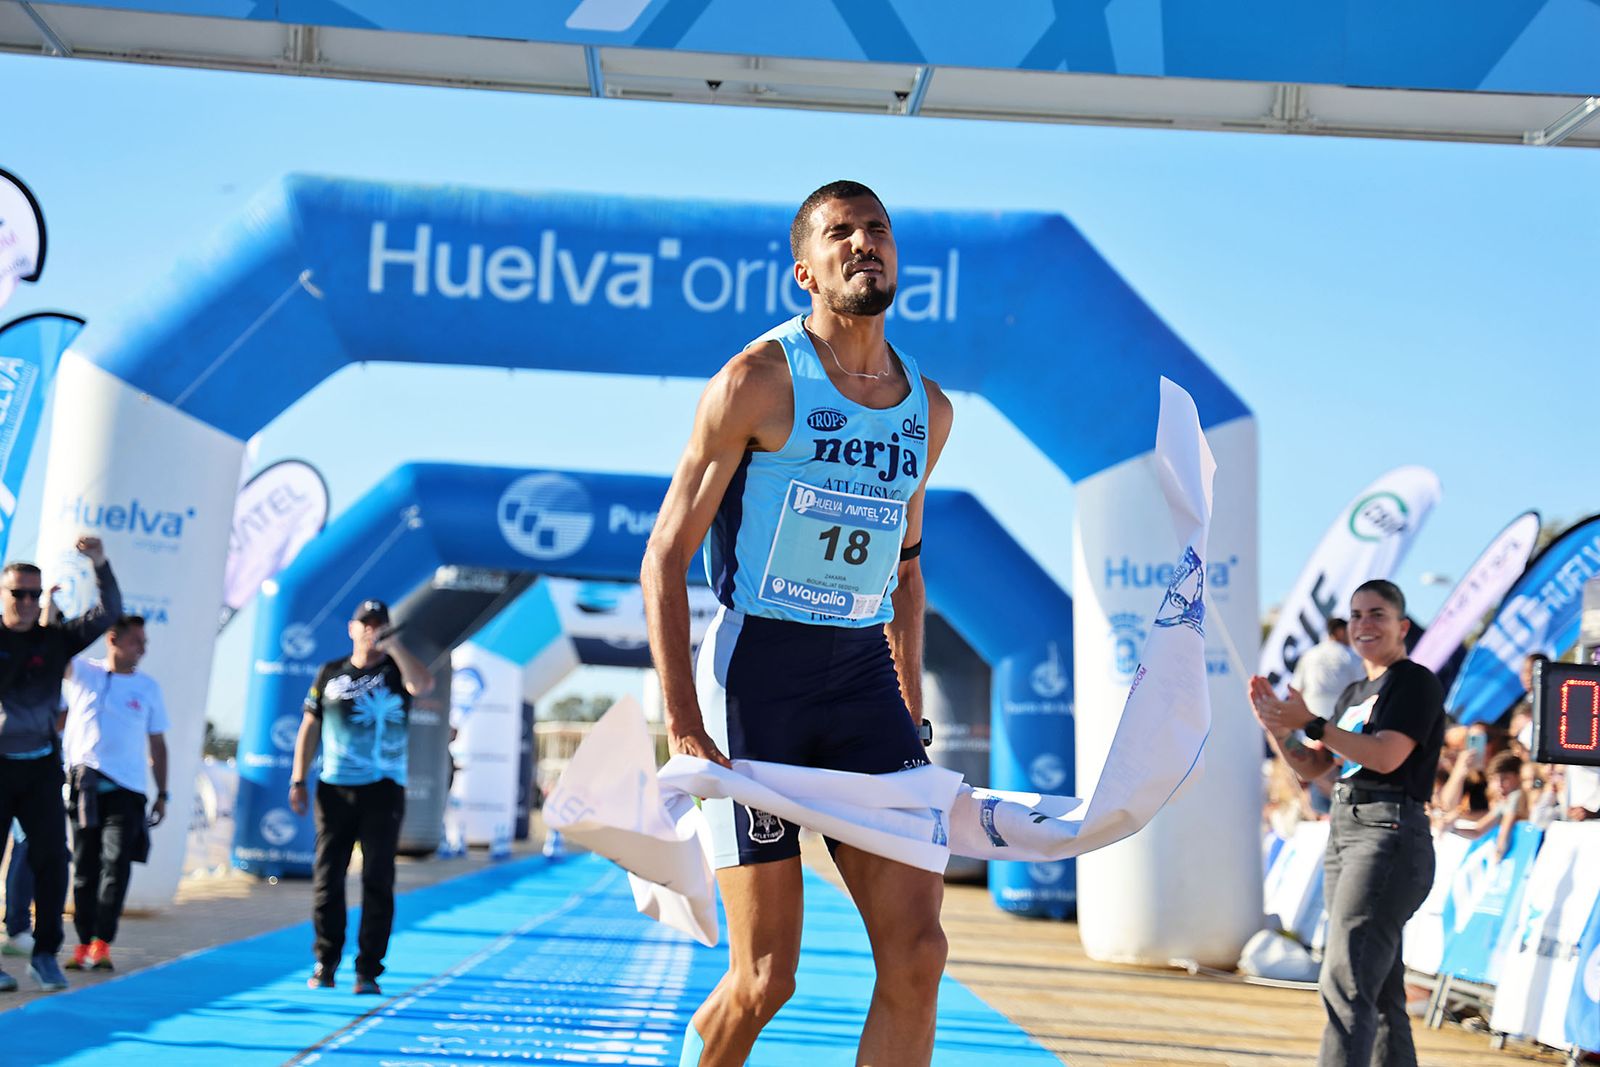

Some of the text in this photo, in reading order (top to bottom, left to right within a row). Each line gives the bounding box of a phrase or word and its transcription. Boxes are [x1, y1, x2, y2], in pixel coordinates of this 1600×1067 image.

[368, 221, 960, 322] Huelva orial
[810, 412, 846, 428] TROPS
[811, 431, 918, 482] nerja
[814, 497, 842, 512] HUELVA
[818, 525, 871, 566] 18
[787, 582, 846, 606] Wayalia
[1560, 678, 1600, 751] 0
